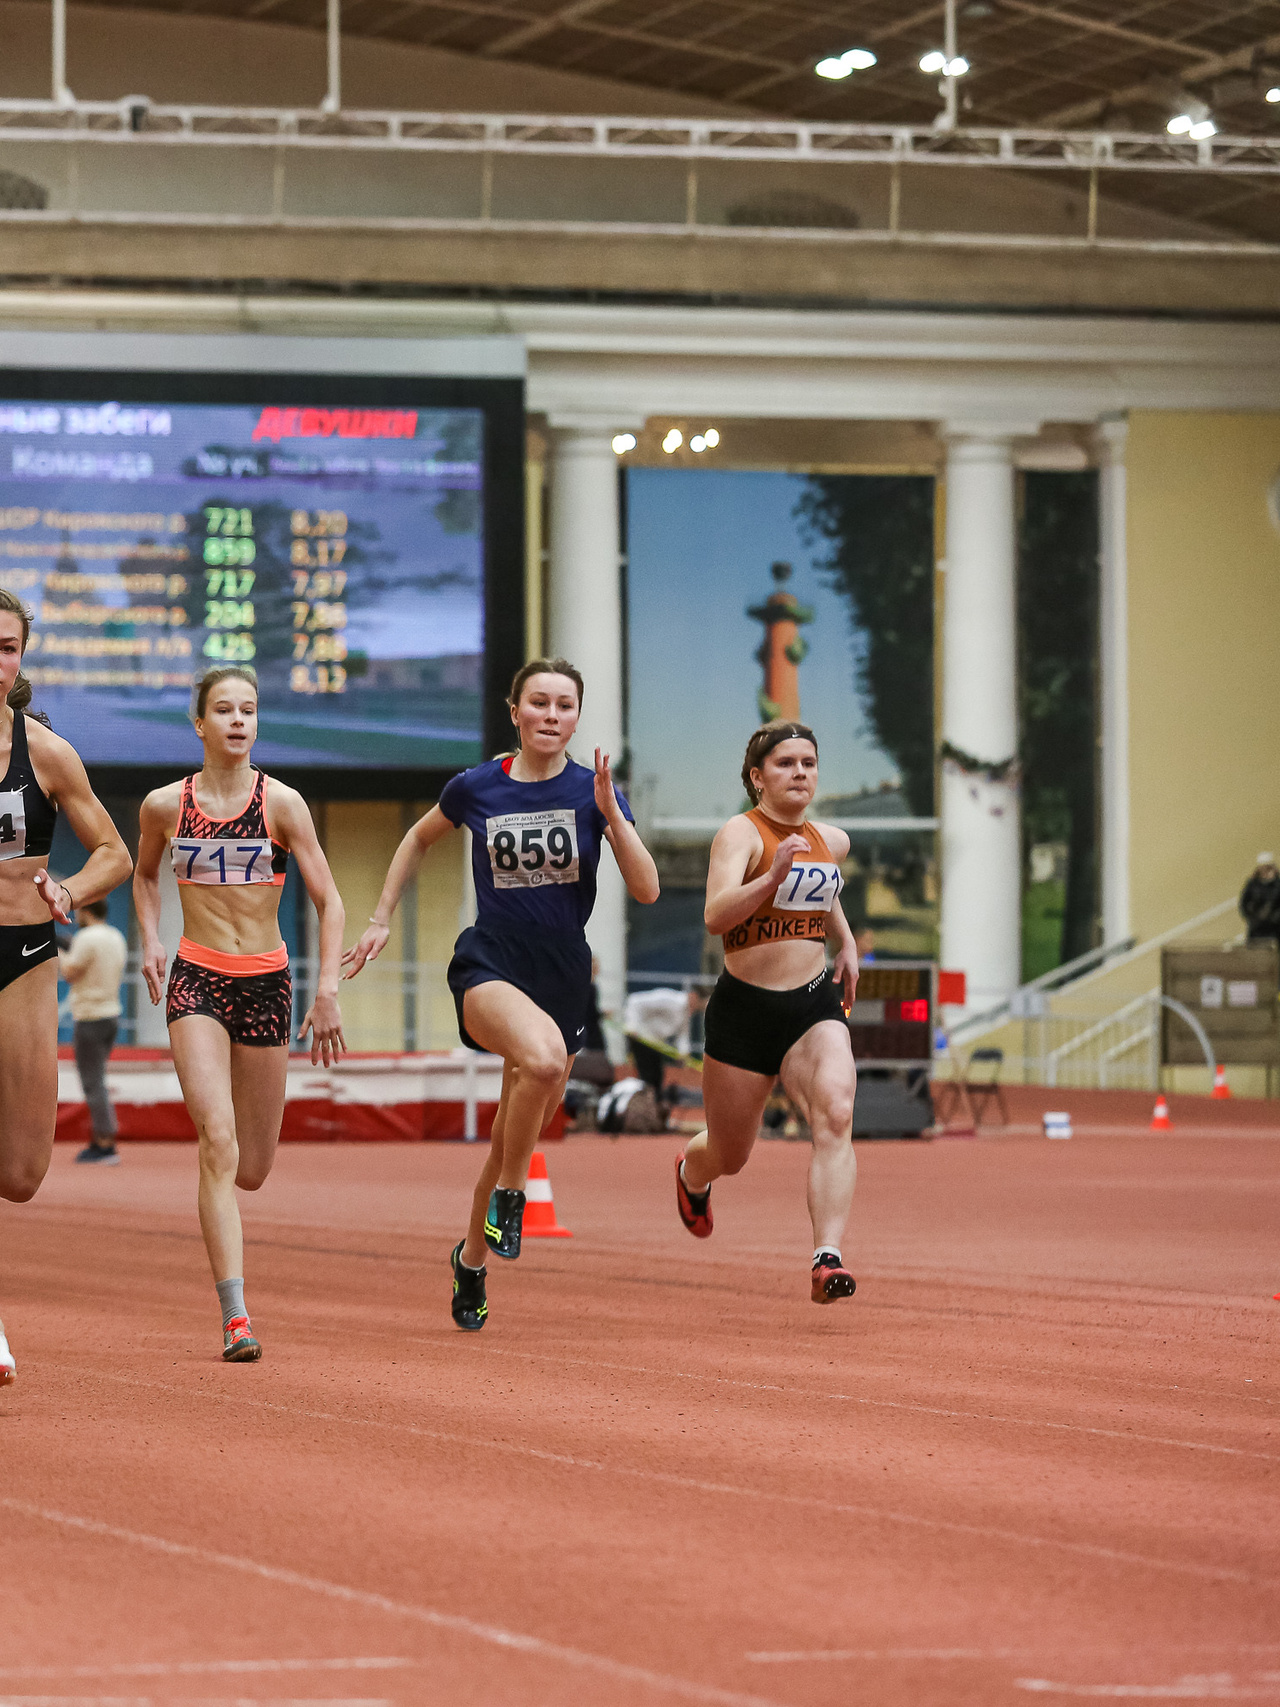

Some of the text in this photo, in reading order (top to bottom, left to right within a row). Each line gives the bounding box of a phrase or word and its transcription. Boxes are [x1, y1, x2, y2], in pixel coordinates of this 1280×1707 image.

[65, 402, 171, 435] забеги
[252, 407, 418, 443] ДЕВУШКИ
[12, 446, 154, 480] Команда
[204, 507, 253, 536] 721
[290, 510, 348, 537] 8,20
[204, 537, 255, 566] 859
[290, 539, 347, 568] 8,17
[204, 568, 255, 598] 717
[290, 570, 348, 599] 7,97
[204, 600, 254, 628] 204
[203, 633, 256, 661] 425
[290, 665, 348, 694] 8,12
[178, 845, 262, 883] 717
[493, 827, 573, 871] 859
[788, 868, 839, 902] 721
[723, 927, 749, 949] RO
[757, 918, 805, 941] NIKE
[808, 915, 826, 935] PR
